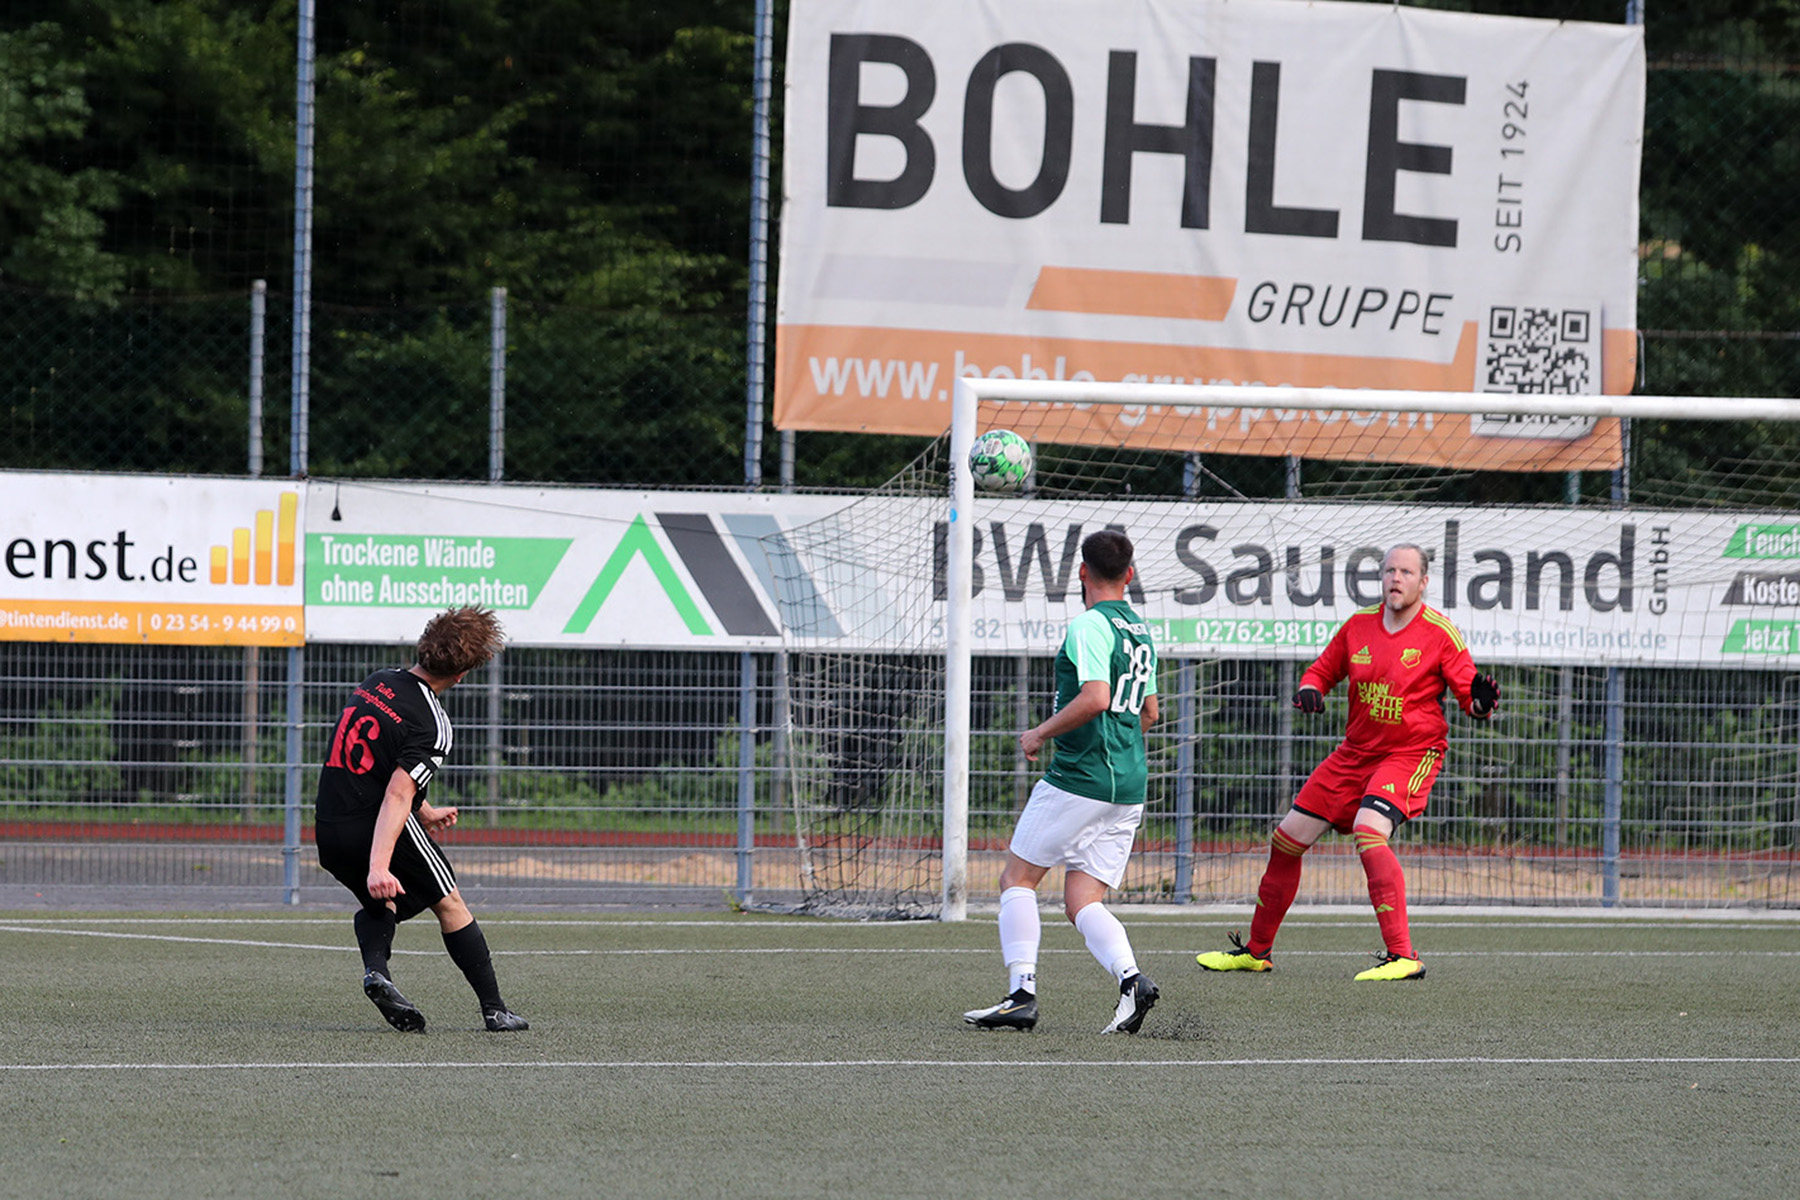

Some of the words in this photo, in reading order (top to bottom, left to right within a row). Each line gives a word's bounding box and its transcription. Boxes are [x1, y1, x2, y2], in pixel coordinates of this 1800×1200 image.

[827, 33, 1467, 248] BOHLE
[1501, 80, 1529, 158] 1924
[1495, 173, 1522, 253] SEIT
[1248, 281, 1454, 335] GRUPPE
[5, 530, 198, 582] enst.de
[320, 536, 419, 567] Trockene
[424, 538, 495, 569] Wände
[1174, 519, 1636, 612] Saueland
[1648, 526, 1670, 615] GmbH
[320, 574, 374, 603] ohne
[378, 575, 528, 606] Ausschachten
[1743, 573, 1799, 604] Koste
[151, 613, 163, 630] 0
[166, 613, 185, 631] 23
[190, 614, 210, 631] 54
[222, 615, 234, 632] 9
[238, 616, 257, 632] 44
[260, 616, 281, 632] 99
[284, 616, 296, 633] 0
[932, 618, 1001, 639] 582
[1147, 619, 1178, 642] el.
[1742, 622, 1791, 652] Jetzt
[375, 682, 396, 699] TuRa
[1111, 638, 1152, 715] 28
[326, 706, 380, 775] 16
